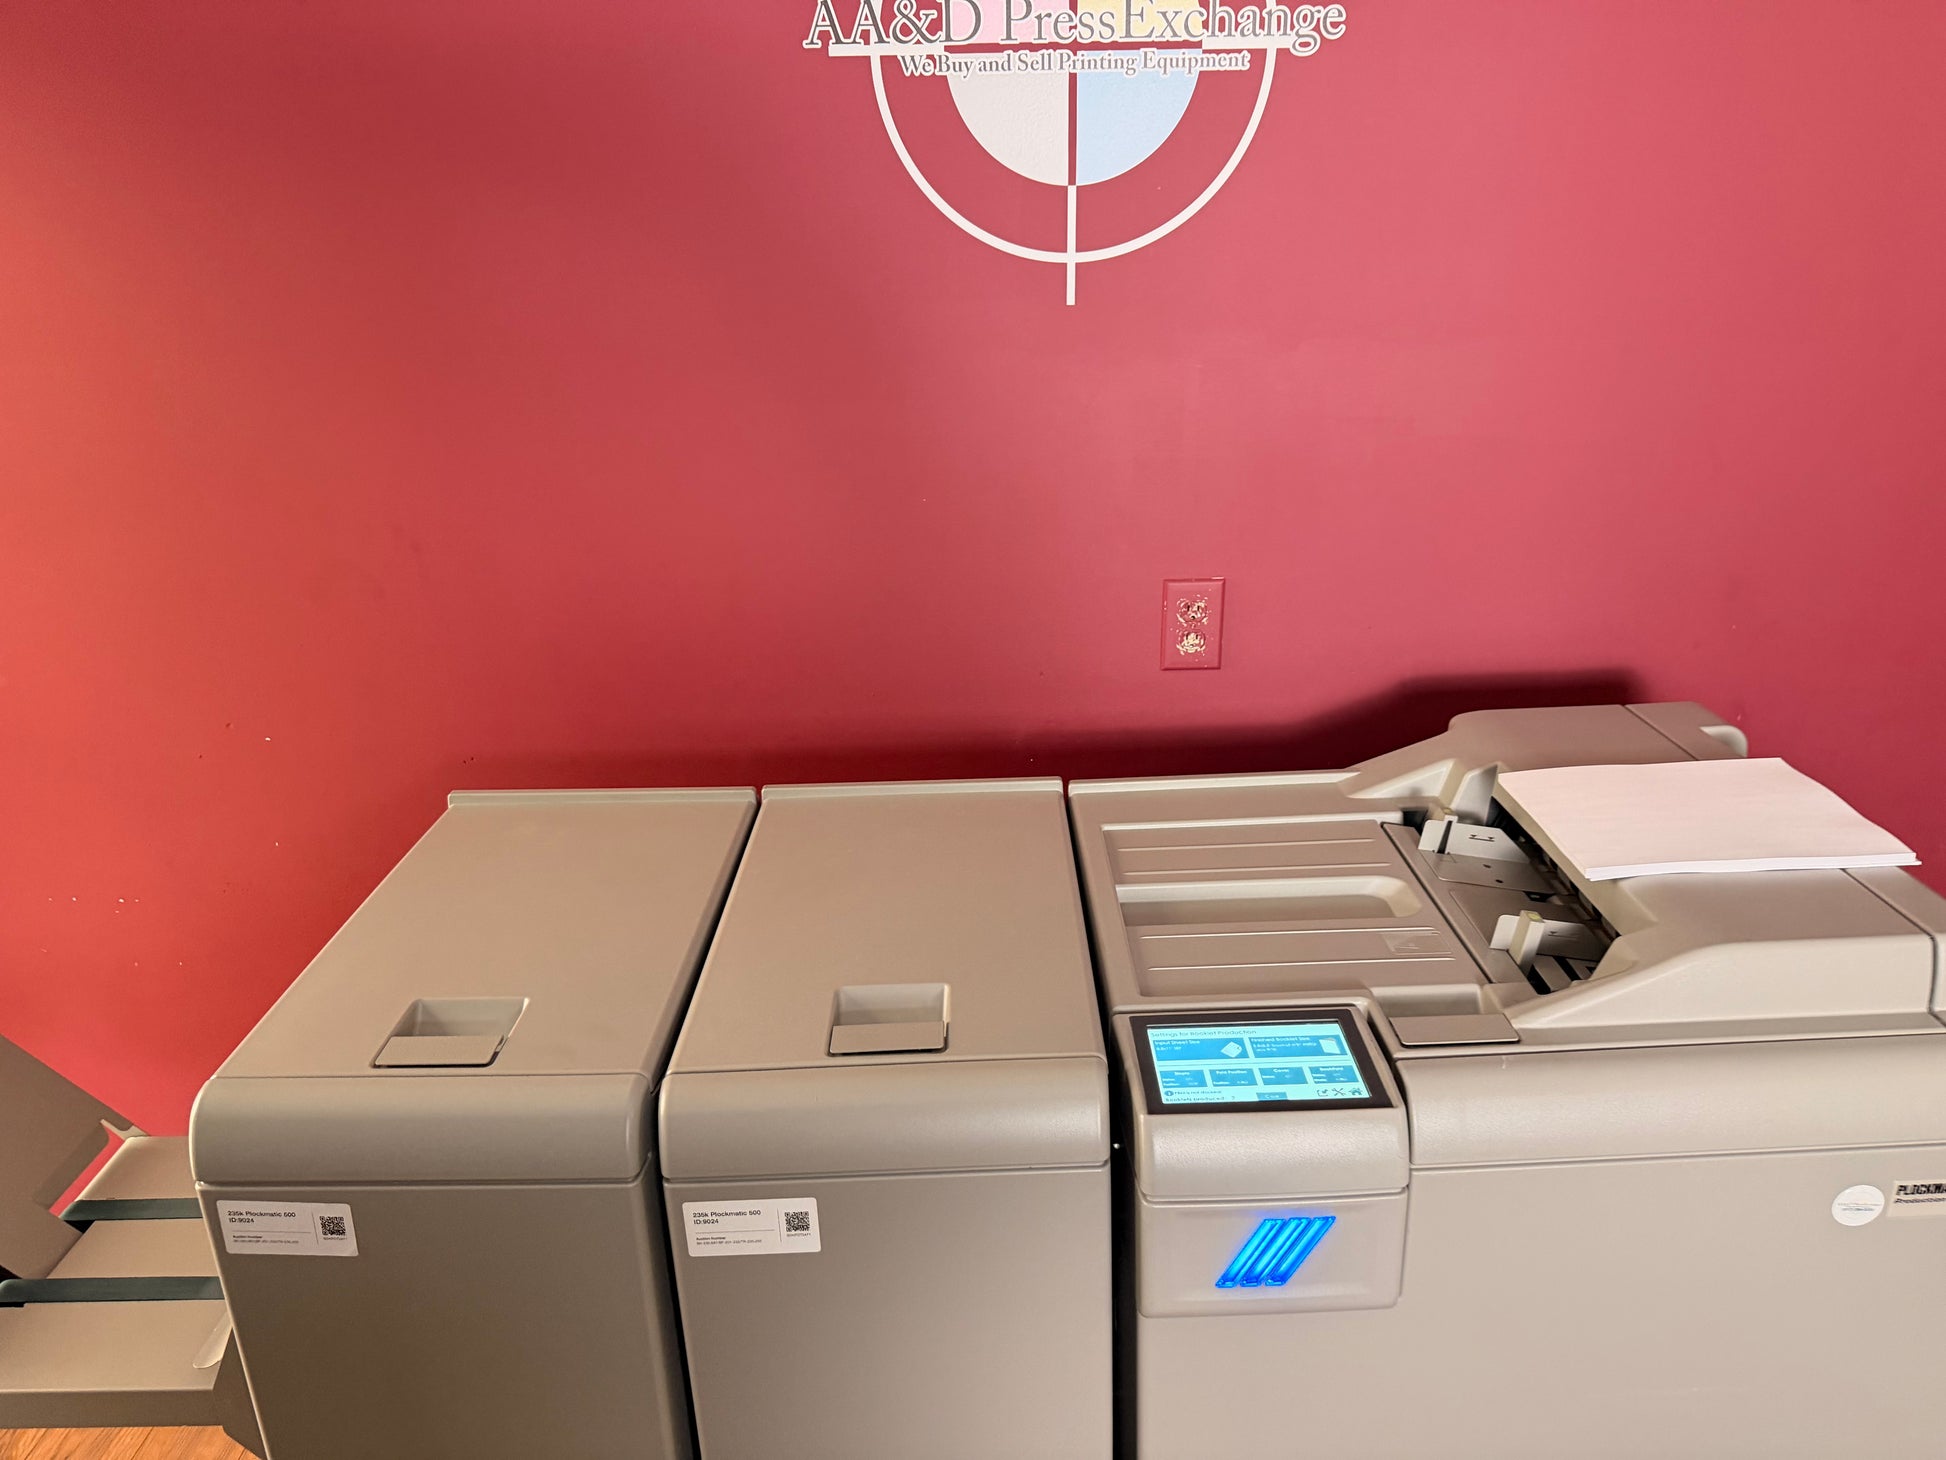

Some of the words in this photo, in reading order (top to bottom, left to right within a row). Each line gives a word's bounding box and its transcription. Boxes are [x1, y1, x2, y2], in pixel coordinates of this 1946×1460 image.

[805, 0, 982, 47] AA&D
[1000, 0, 1346, 55] PressExchange
[900, 54, 932, 74] We
[936, 54, 973, 78] Buy
[978, 52, 1012, 72] and
[1017, 52, 1052, 71] Sell
[1058, 51, 1138, 75] Printing
[1141, 51, 1250, 74] Equipment
